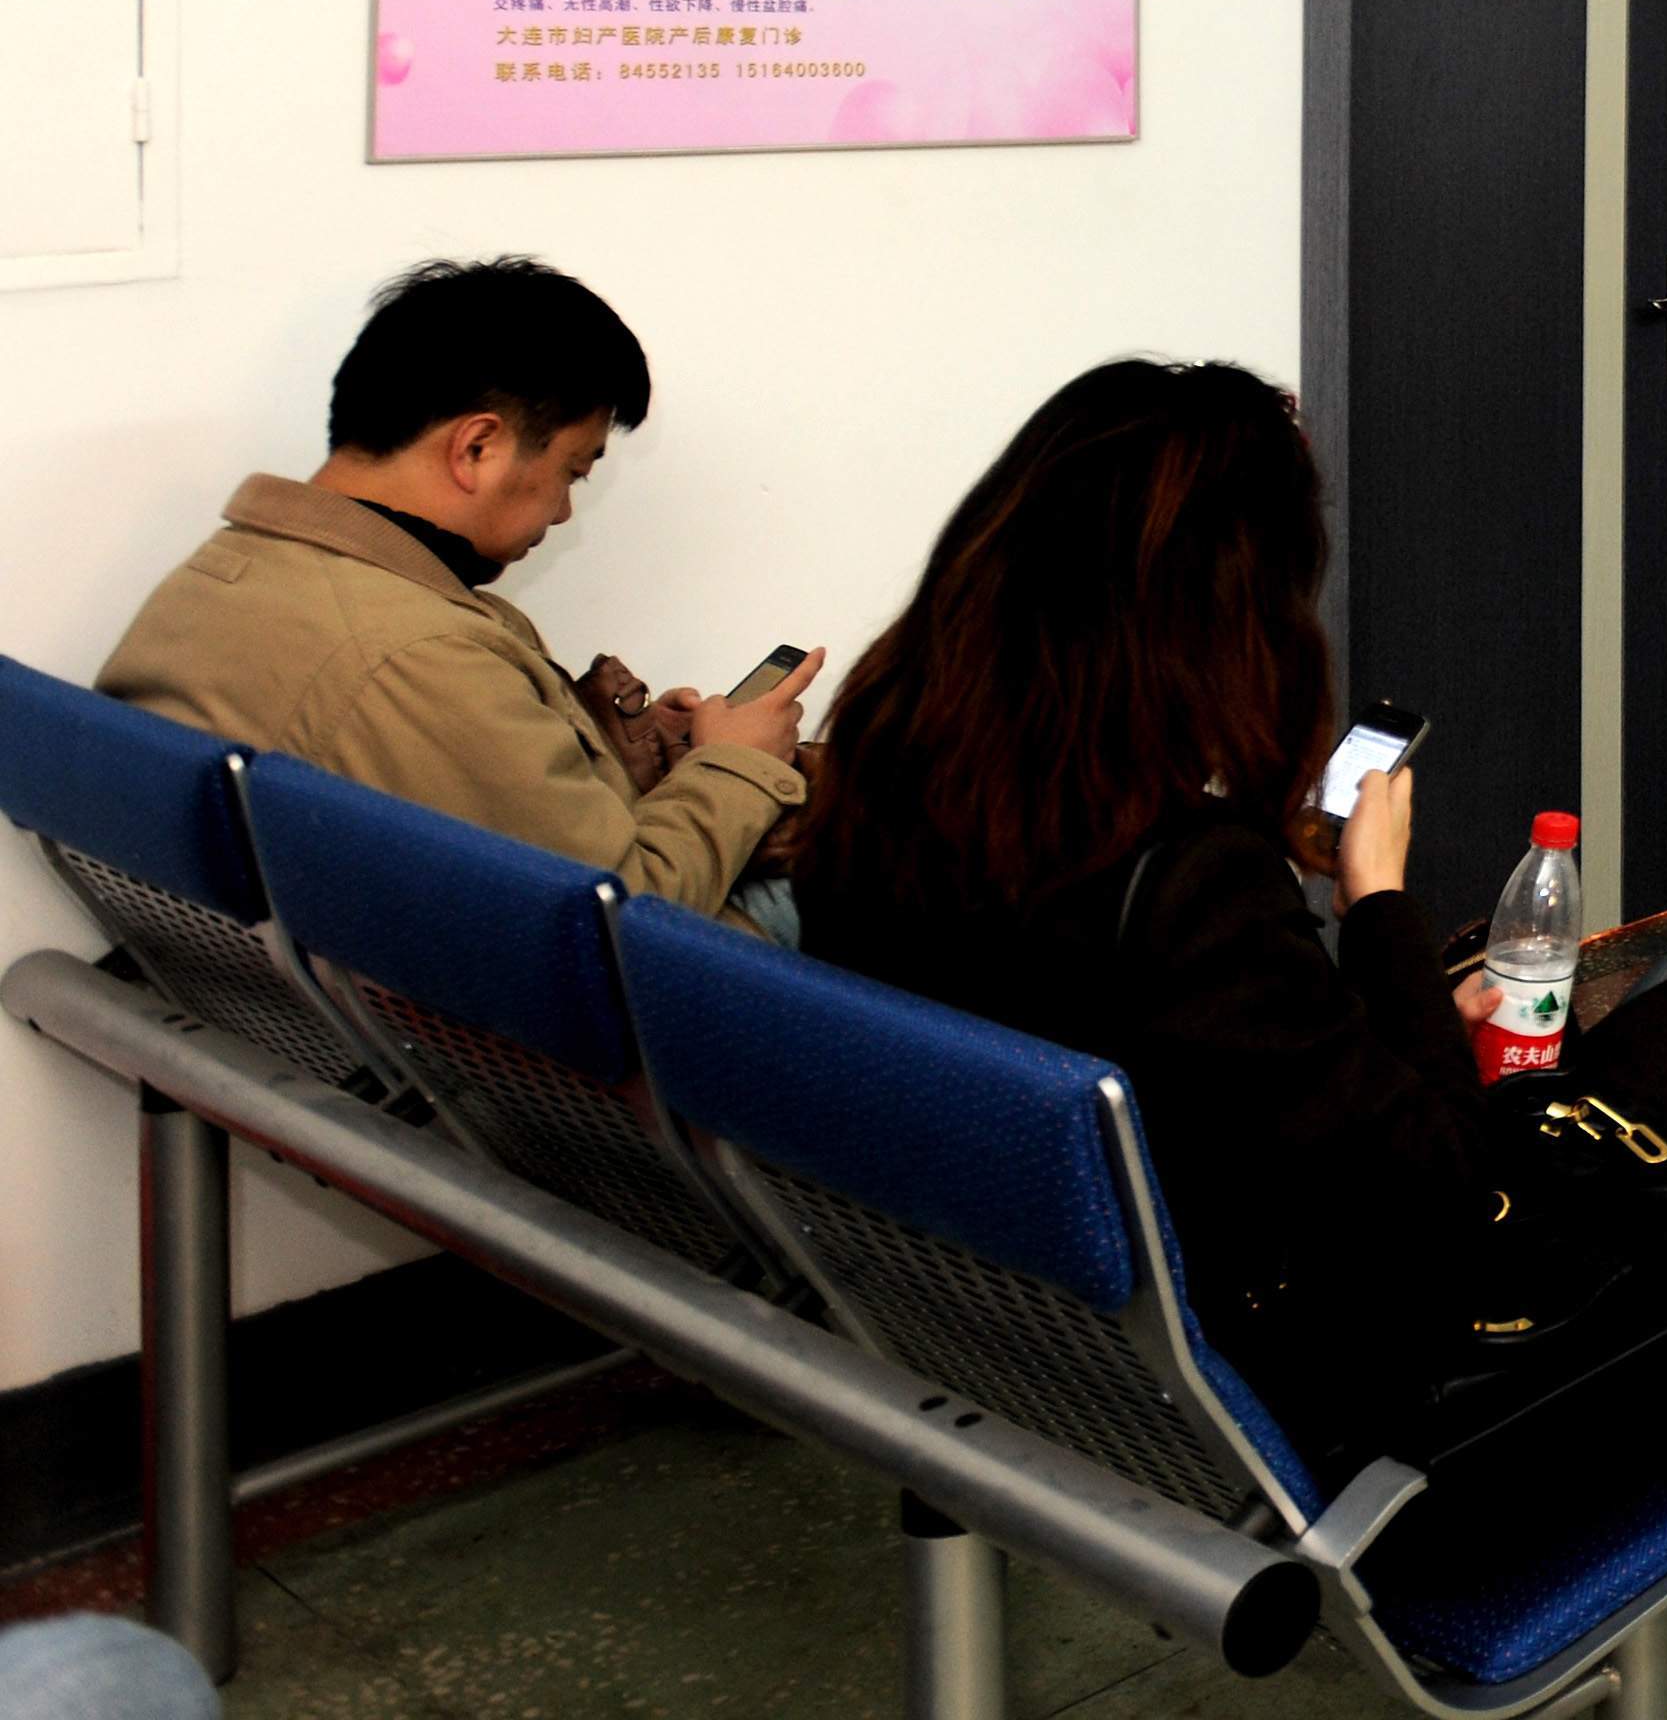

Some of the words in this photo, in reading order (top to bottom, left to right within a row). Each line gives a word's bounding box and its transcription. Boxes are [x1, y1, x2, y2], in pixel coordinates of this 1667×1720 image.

[496, 26, 803, 47] 大连市妇产医院产后康复门诊
[495, 62, 603, 82] 联系电话：
[619, 63, 720, 80] 84552135
[736, 62, 866, 80] 15164003600
